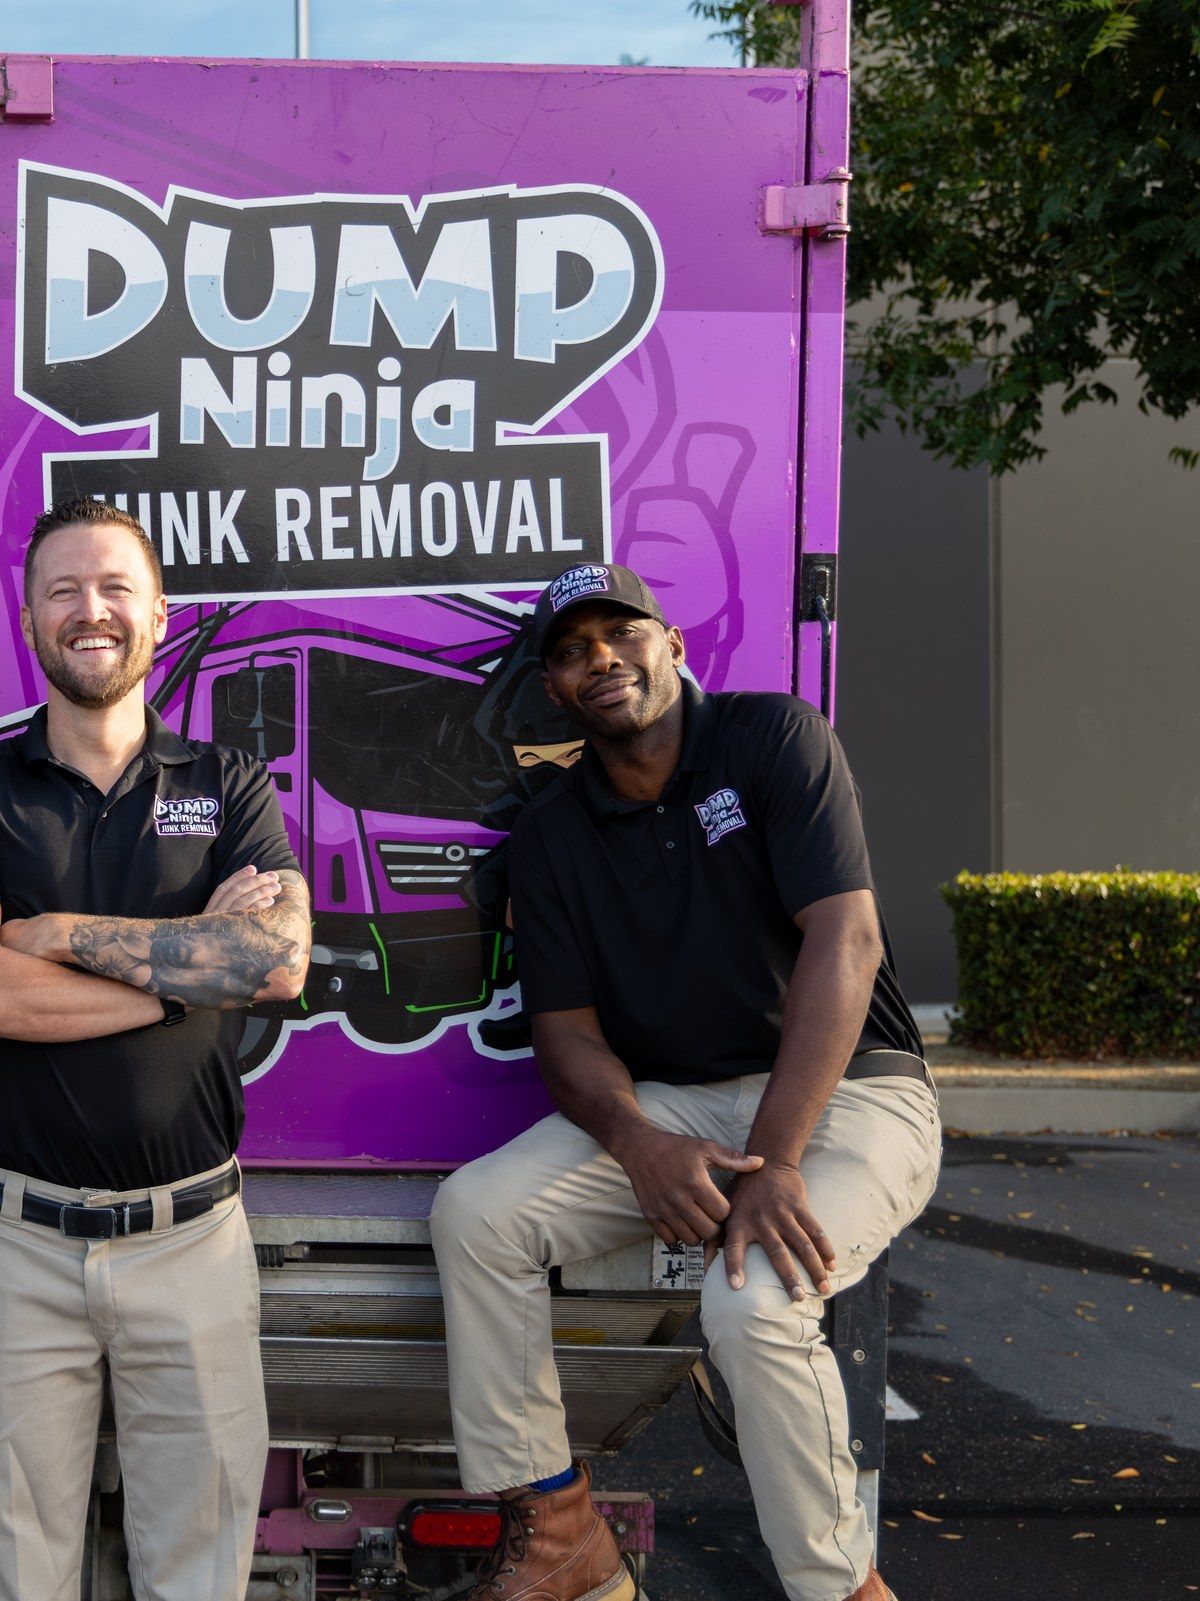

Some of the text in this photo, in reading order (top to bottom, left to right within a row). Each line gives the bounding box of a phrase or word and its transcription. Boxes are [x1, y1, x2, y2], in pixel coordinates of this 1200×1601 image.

[45, 196, 635, 365] DUMP
[179, 351, 476, 481] Ninja
[92, 478, 584, 566] NK REMOVAL
[552, 567, 605, 596] DUMP
[156, 800, 216, 816] DUMP
[169, 812, 201, 825] Ninja
[698, 791, 737, 824] DMP
[181, 824, 213, 833] REMOVAL
[716, 815, 743, 834] EMOVAL
